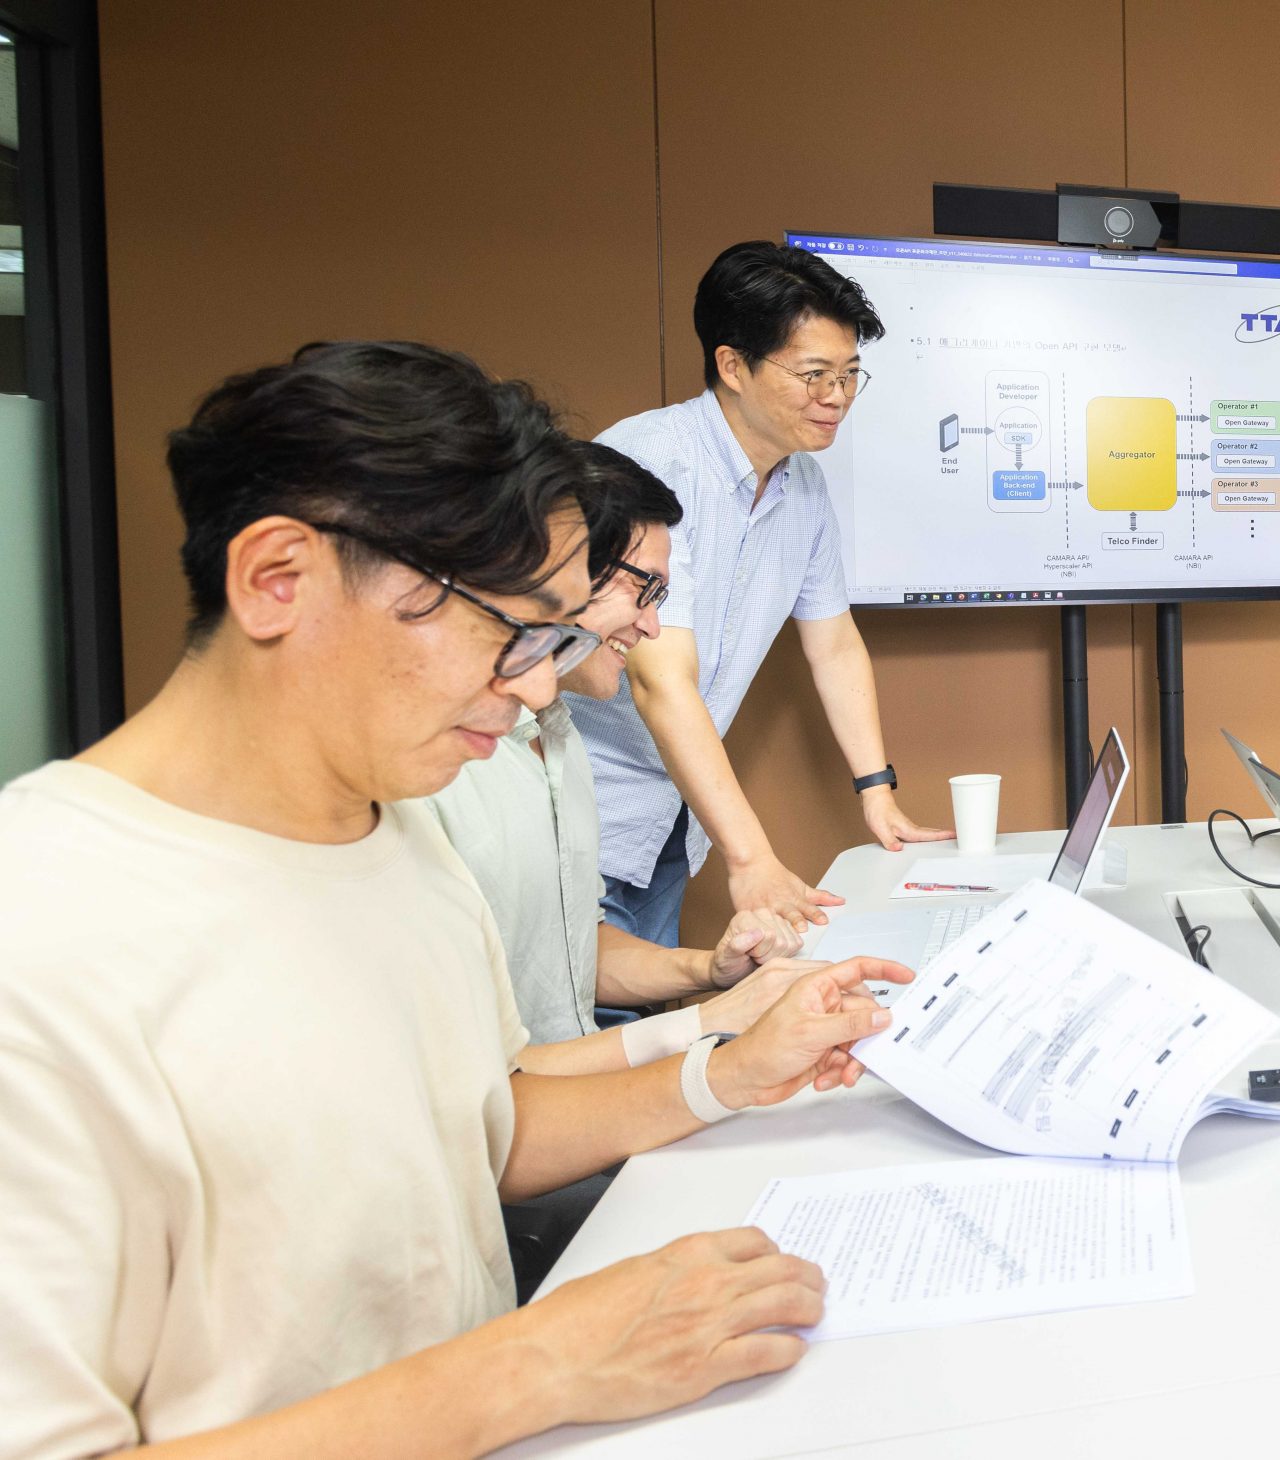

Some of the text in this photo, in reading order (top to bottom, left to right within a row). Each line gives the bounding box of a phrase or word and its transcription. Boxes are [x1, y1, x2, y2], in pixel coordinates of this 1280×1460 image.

[916, 337, 931, 346] 5.1
[1034, 340, 1059, 351] Open
[1062, 342, 1078, 351] API
[996, 383, 1040, 391] Application
[999, 392, 1038, 401] Developer
[1217, 402, 1248, 410] Operator
[999, 422, 1038, 430] Application
[1243, 419, 1269, 427] Gateway
[1217, 442, 1248, 450] Operator
[1108, 450, 1156, 460] Aggregator
[942, 457, 958, 465] End
[1242, 458, 1268, 466] Gateway
[1217, 480, 1248, 488] Operator
[1242, 495, 1269, 503] Gateway
[1107, 537, 1158, 545] Telco Finder
[1174, 554, 1202, 562] CAMARA
